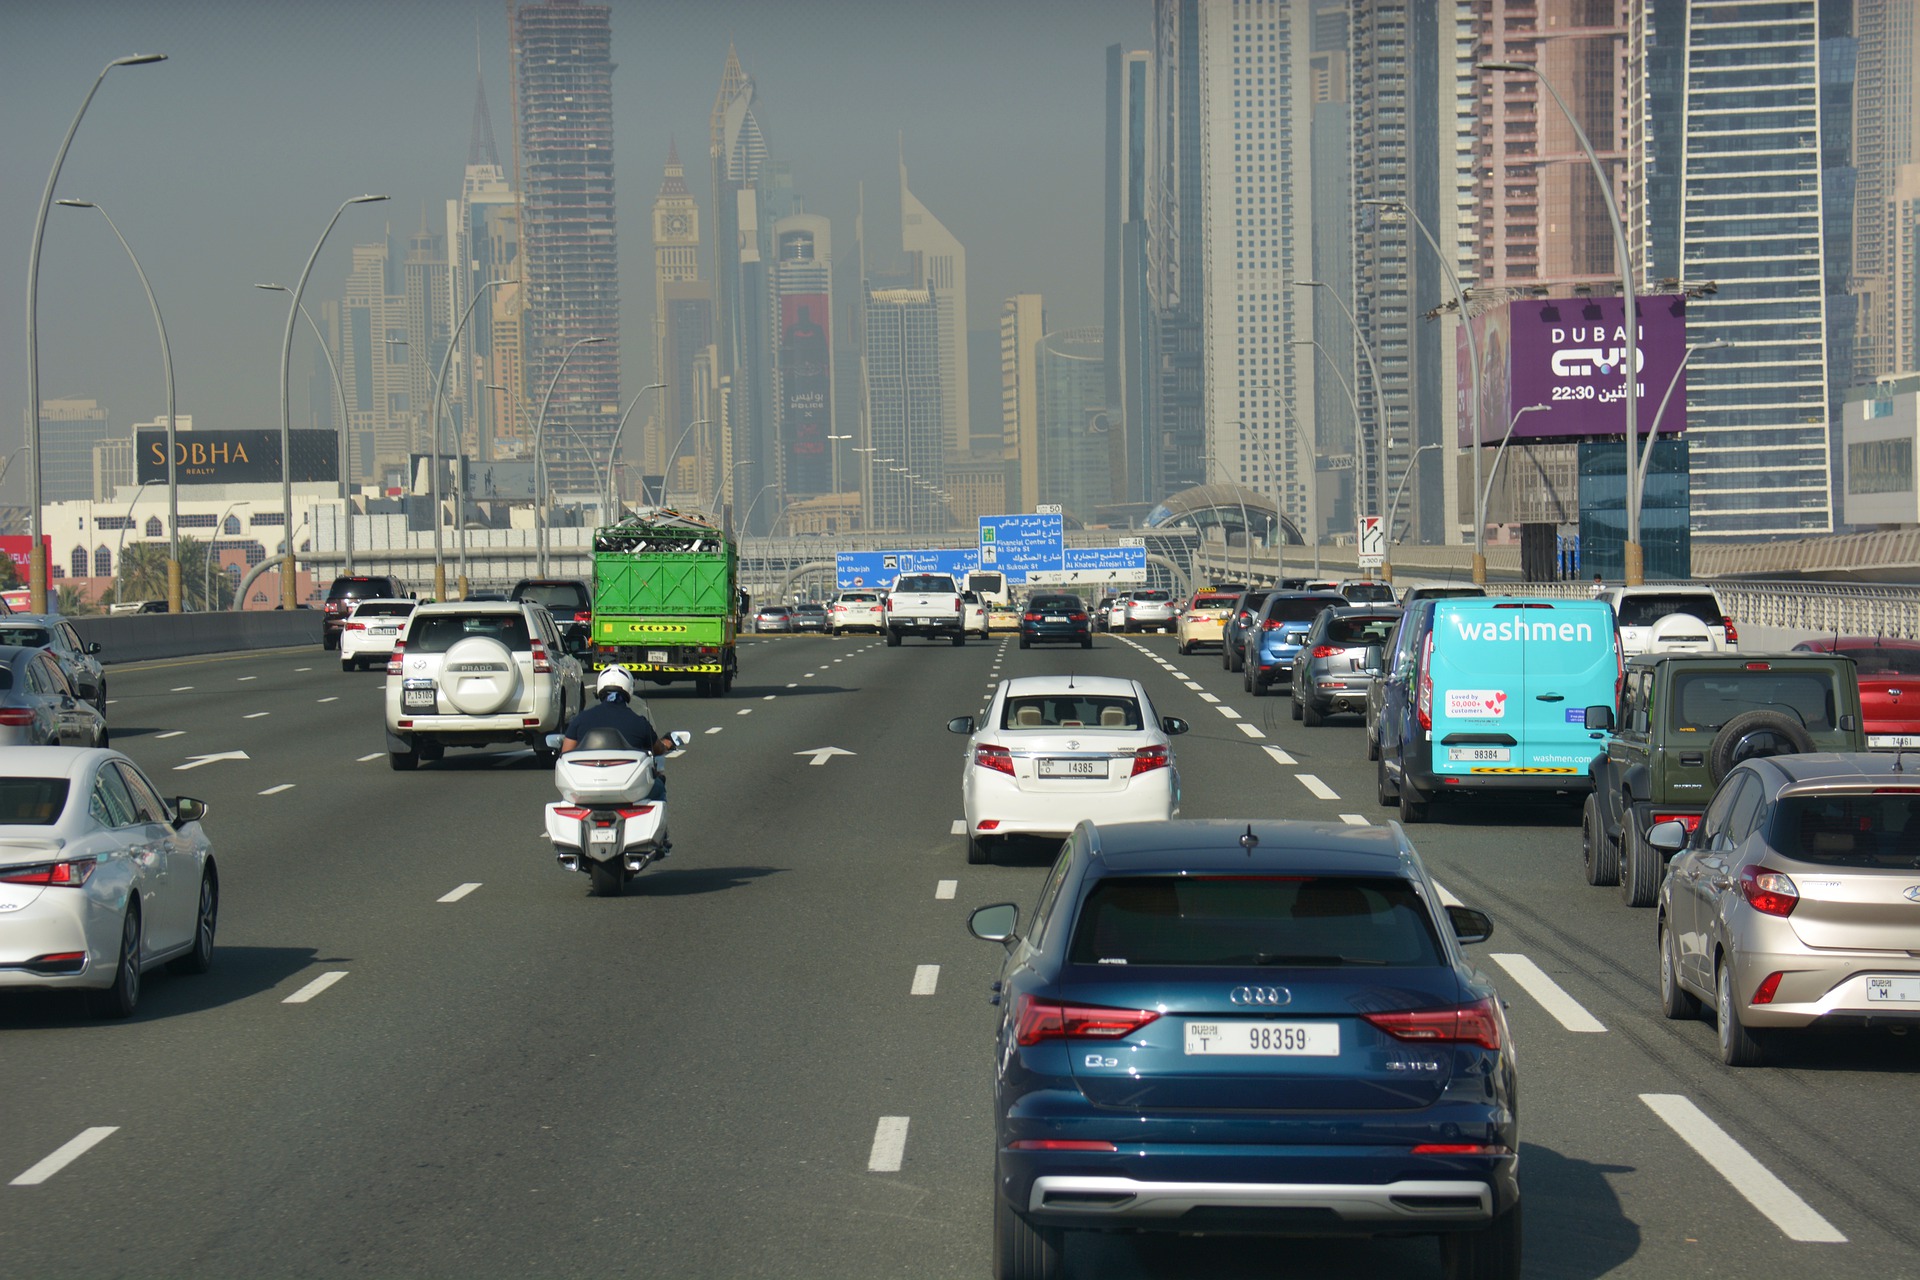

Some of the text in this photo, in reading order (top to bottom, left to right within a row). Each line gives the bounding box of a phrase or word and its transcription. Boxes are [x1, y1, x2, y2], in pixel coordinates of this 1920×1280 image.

[1552, 325, 1643, 344] DUBAI
[1552, 385, 1595, 400] 22:30
[151, 441, 249, 465] SOBHA
[1049, 505, 1060, 513] 50
[1042, 518, 1060, 527] شارع
[1042, 529, 1060, 538] شارع
[1043, 553, 1061, 562] شارع
[1125, 551, 1144, 560] شارع
[1458, 615, 1592, 642] washmen
[1474, 750, 1498, 759] 98384
[1532, 754, 1592, 763] washmen.com
[1068, 762, 1093, 773] 14385
[1880, 989, 1888, 998] M
[1250, 1028, 1306, 1050] 98359
[1200, 1038, 1210, 1051] T
[1085, 1054, 1118, 1068] Q3
